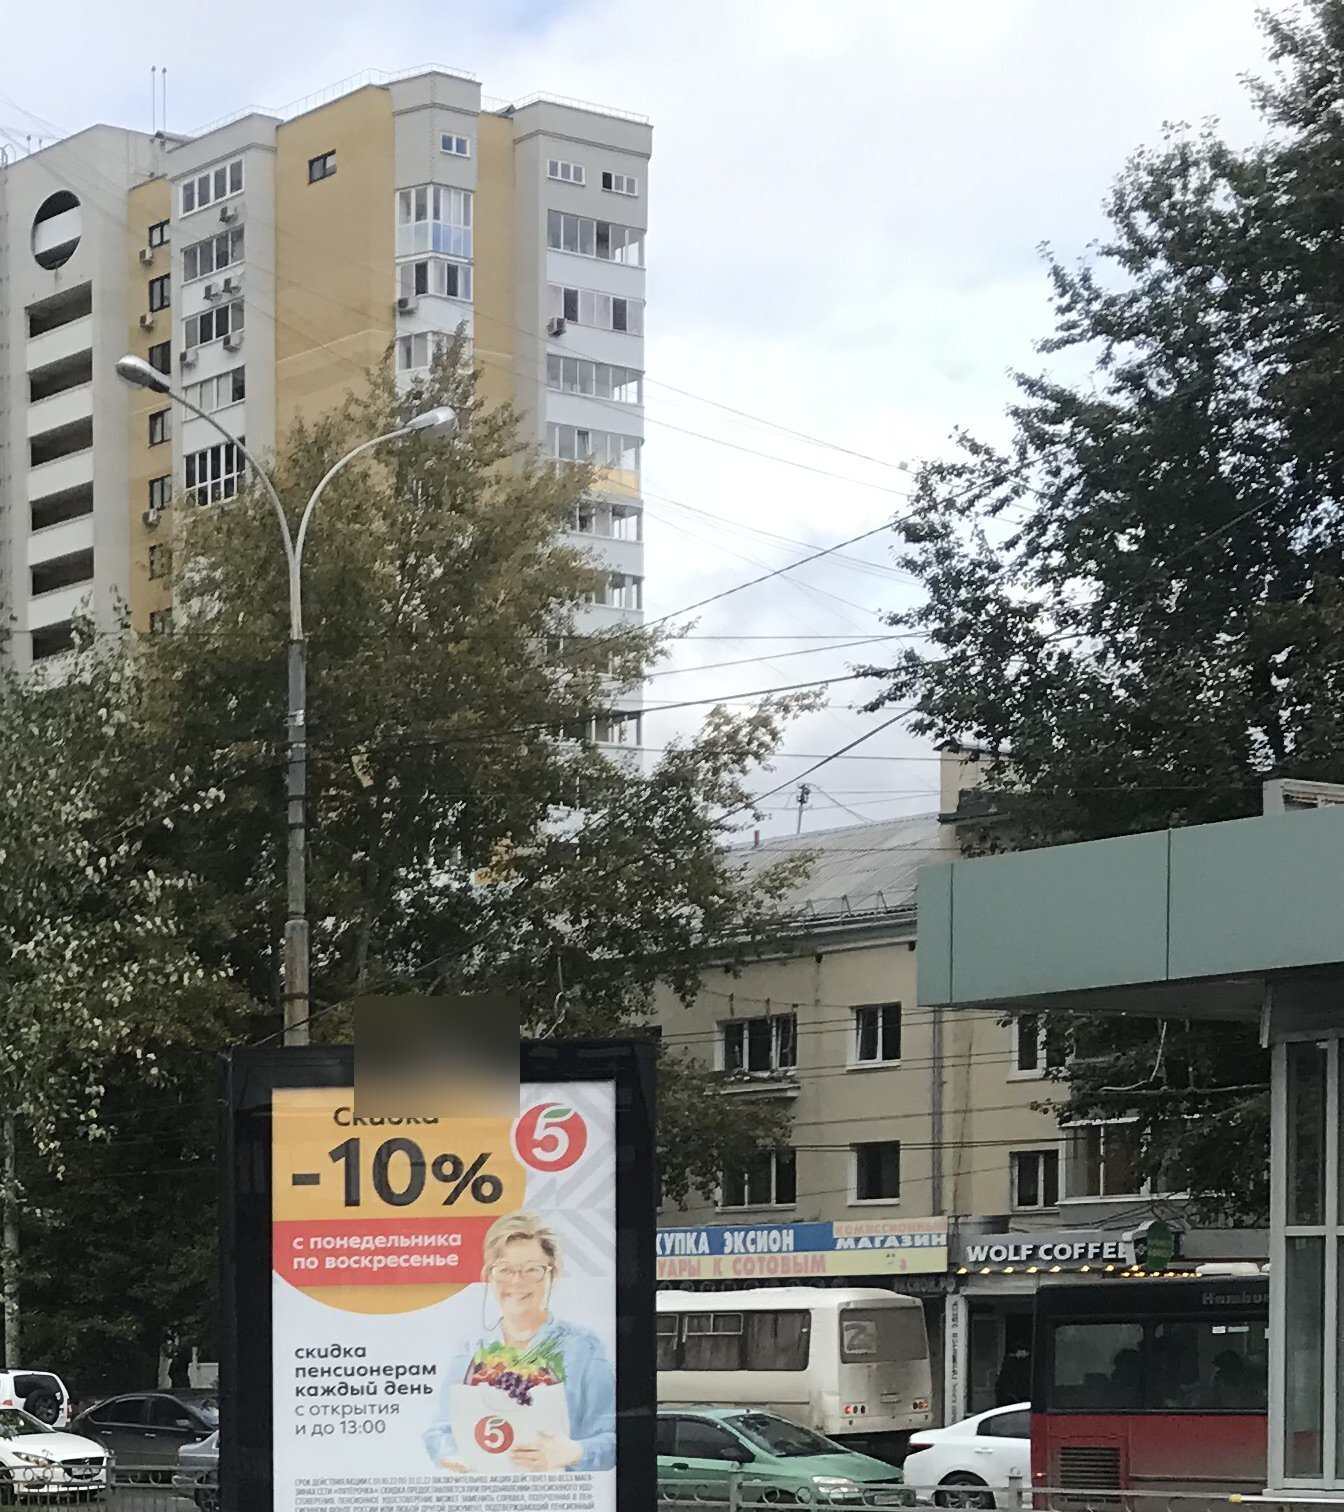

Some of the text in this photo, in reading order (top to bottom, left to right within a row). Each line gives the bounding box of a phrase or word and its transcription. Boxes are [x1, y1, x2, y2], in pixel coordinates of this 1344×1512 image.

[292, 1137, 503, 1207] -10%
[293, 1232, 462, 1250] с понедельника
[723, 1229, 794, 1254] ЭКСИОН
[835, 1234, 946, 1249] МАГАЗИН
[966, 1244, 1034, 1262] WOLF
[293, 1254, 459, 1272] по воскресенье
[713, 1258, 723, 1276] К
[732, 1253, 826, 1275] СОТОВЫМ
[295, 1344, 367, 1359] скидка
[295, 1363, 437, 1379] пенсионерам
[295, 1381, 434, 1397] каждый день
[295, 1402, 400, 1418] с открытия
[295, 1420, 386, 1437] и до 13:00
